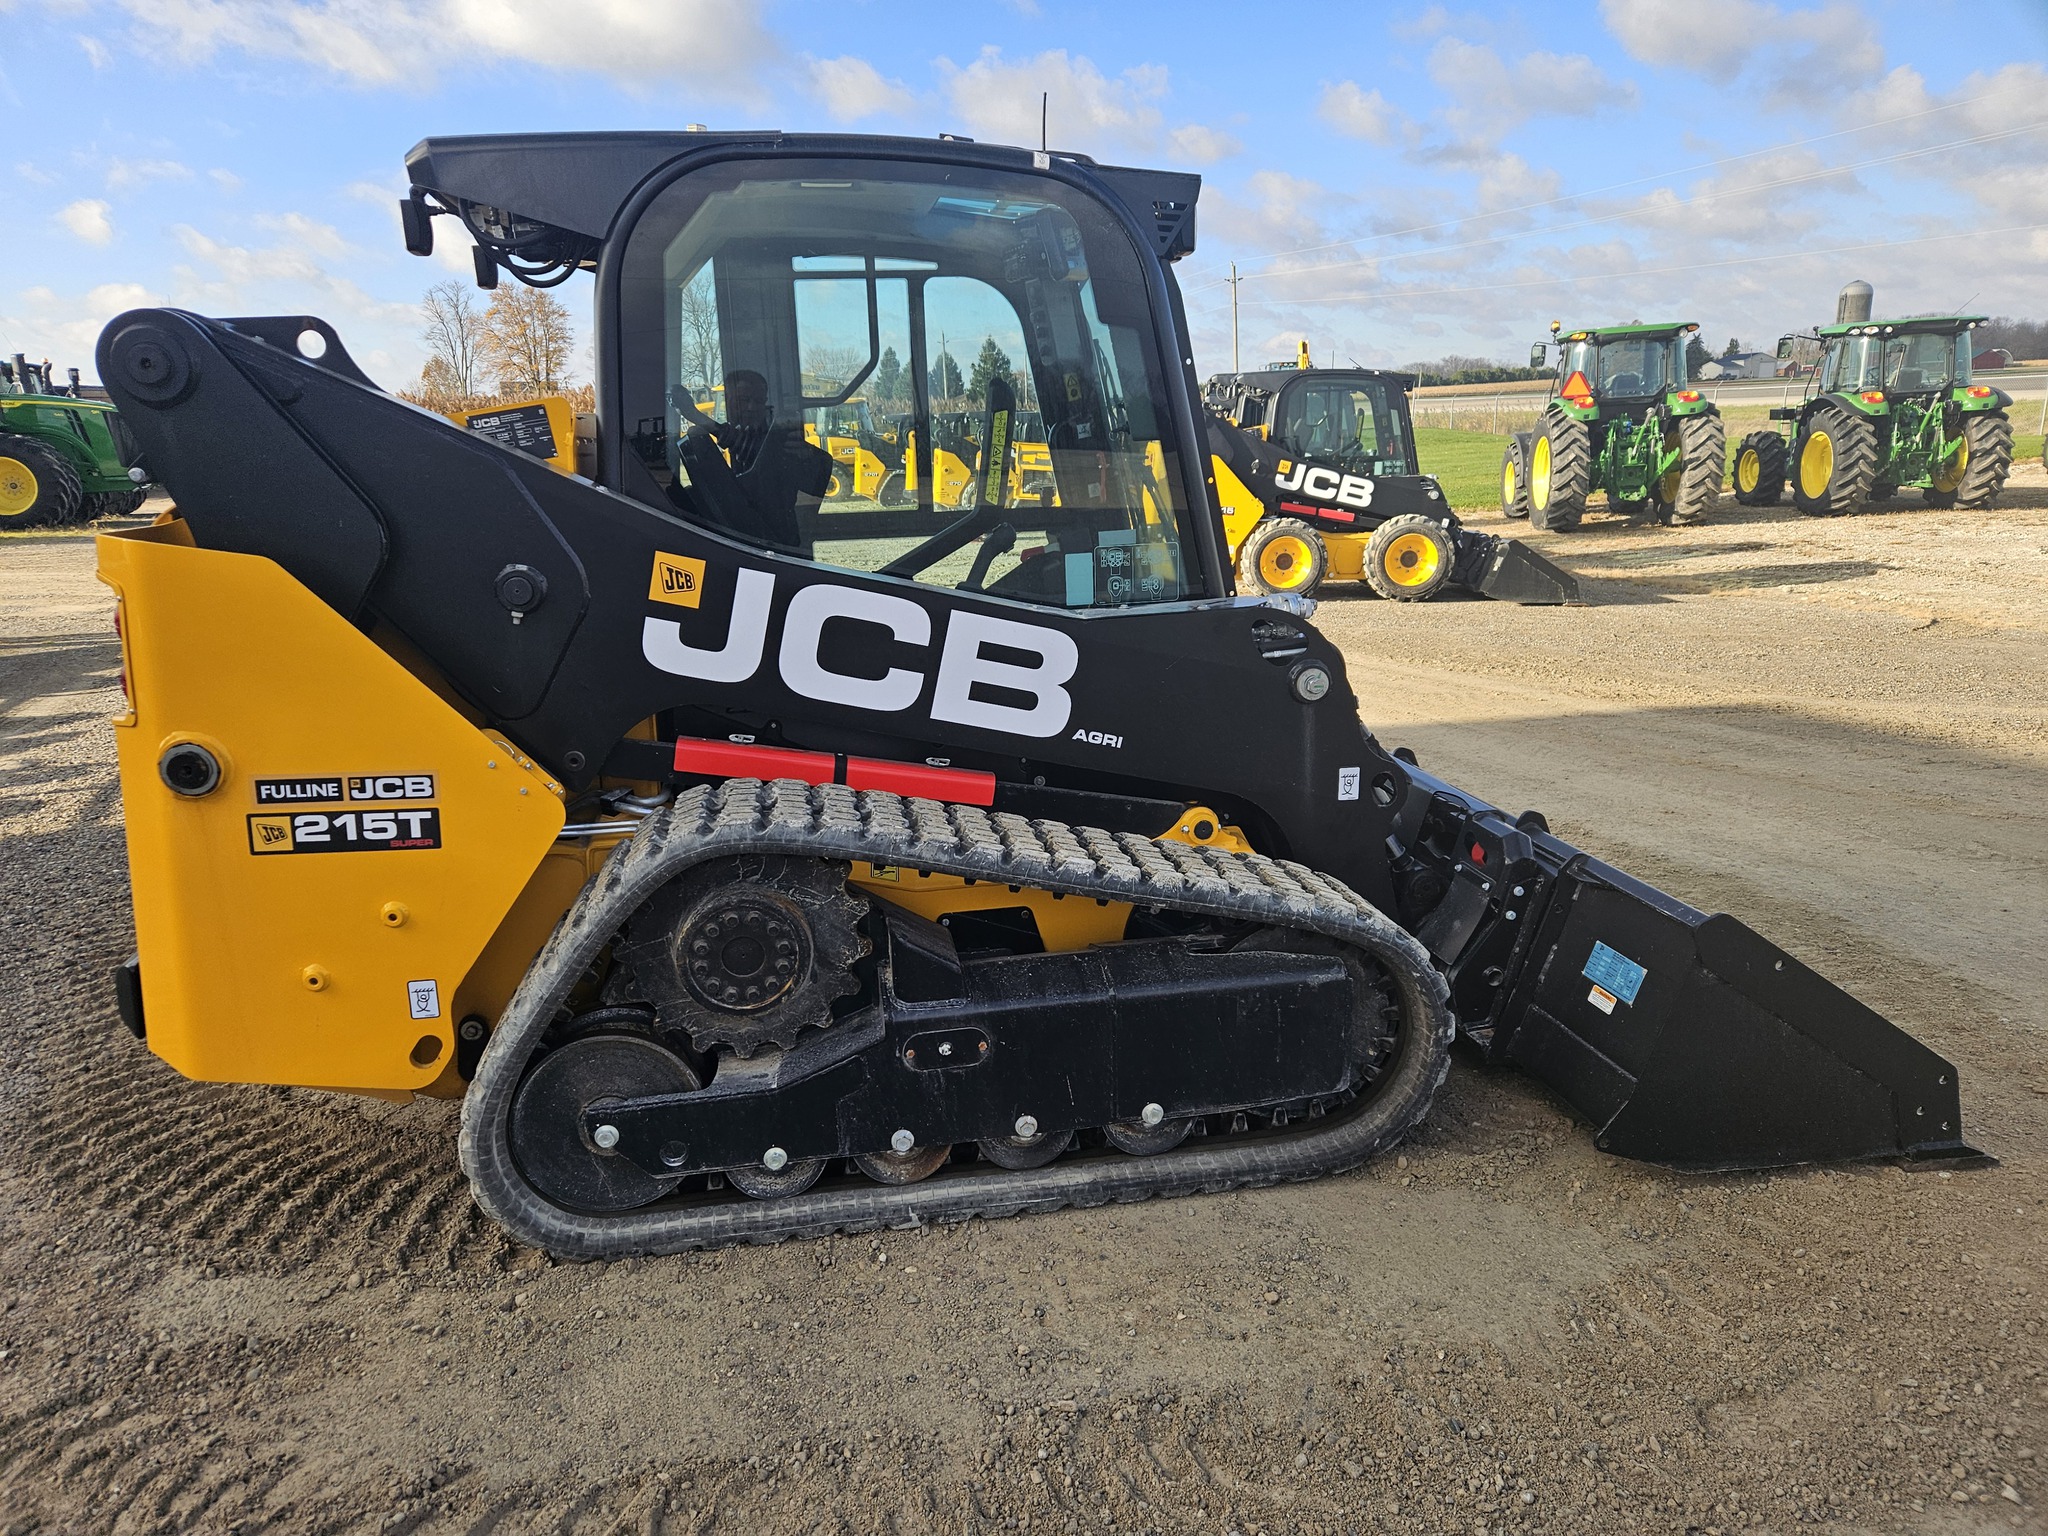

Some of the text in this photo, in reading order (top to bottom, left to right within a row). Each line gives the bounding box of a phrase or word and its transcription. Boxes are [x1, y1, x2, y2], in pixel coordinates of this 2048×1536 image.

[473, 416, 501, 429] JCB
[841, 447, 855, 455] JC
[1275, 463, 1375, 508] JCB
[1220, 506, 1234, 514] 15
[664, 566, 693, 591] JCB
[642, 567, 1079, 738] JCB
[1072, 728, 1123, 748] AGRI
[260, 777, 433, 799] FULLINE JCB
[262, 826, 287, 843] JCB
[294, 811, 432, 842] 215T
[390, 838, 433, 848] SUPER
